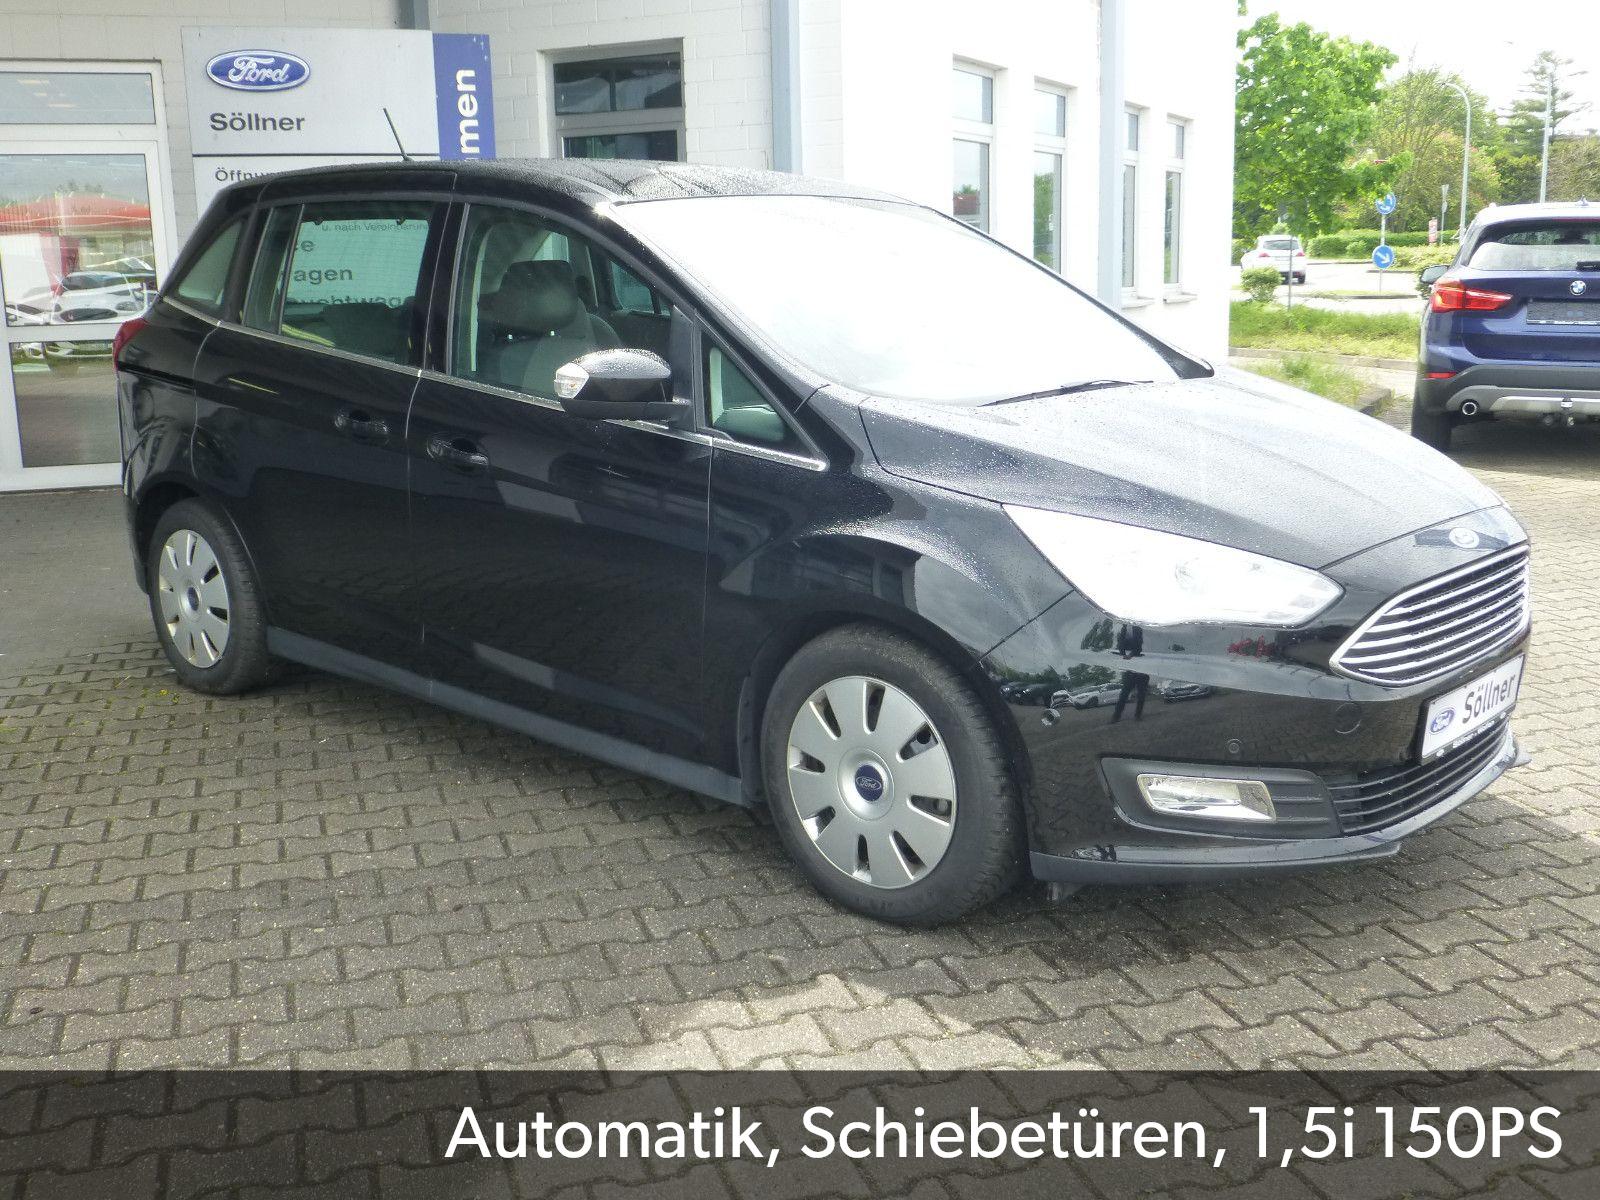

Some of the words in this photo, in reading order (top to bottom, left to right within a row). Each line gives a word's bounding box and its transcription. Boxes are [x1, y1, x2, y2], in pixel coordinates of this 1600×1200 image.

[228, 56, 291, 83] Ford
[210, 112, 305, 131] Söllner
[455, 69, 480, 161] men
[293, 269, 353, 285] agen
[1462, 674, 1516, 724] Söllner
